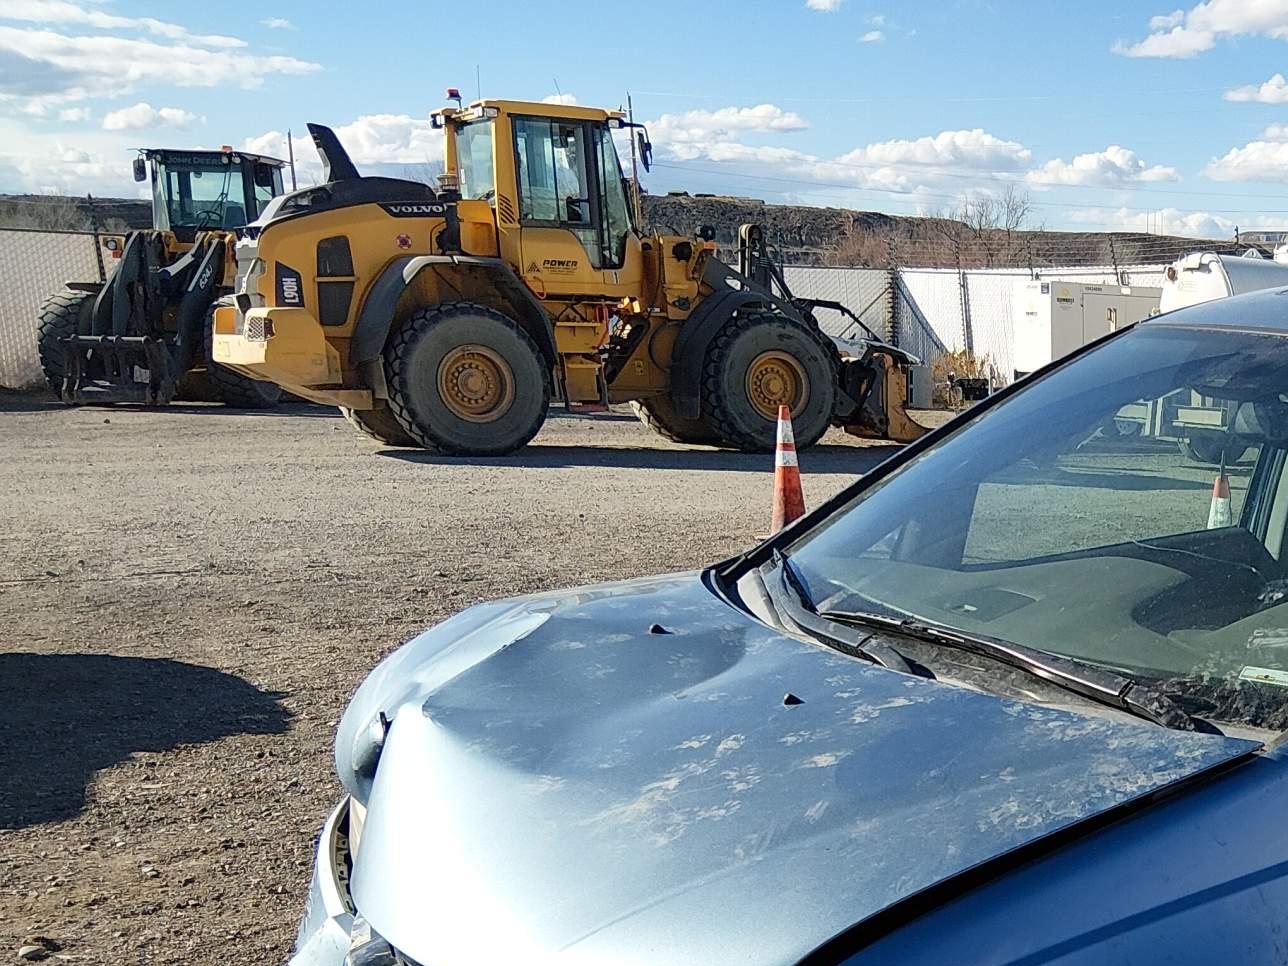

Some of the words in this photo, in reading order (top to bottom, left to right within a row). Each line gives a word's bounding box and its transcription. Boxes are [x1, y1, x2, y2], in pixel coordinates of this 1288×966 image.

[389, 205, 443, 213] VOLVO
[543, 259, 578, 267] POWER
[282, 278, 300, 303] L90H
